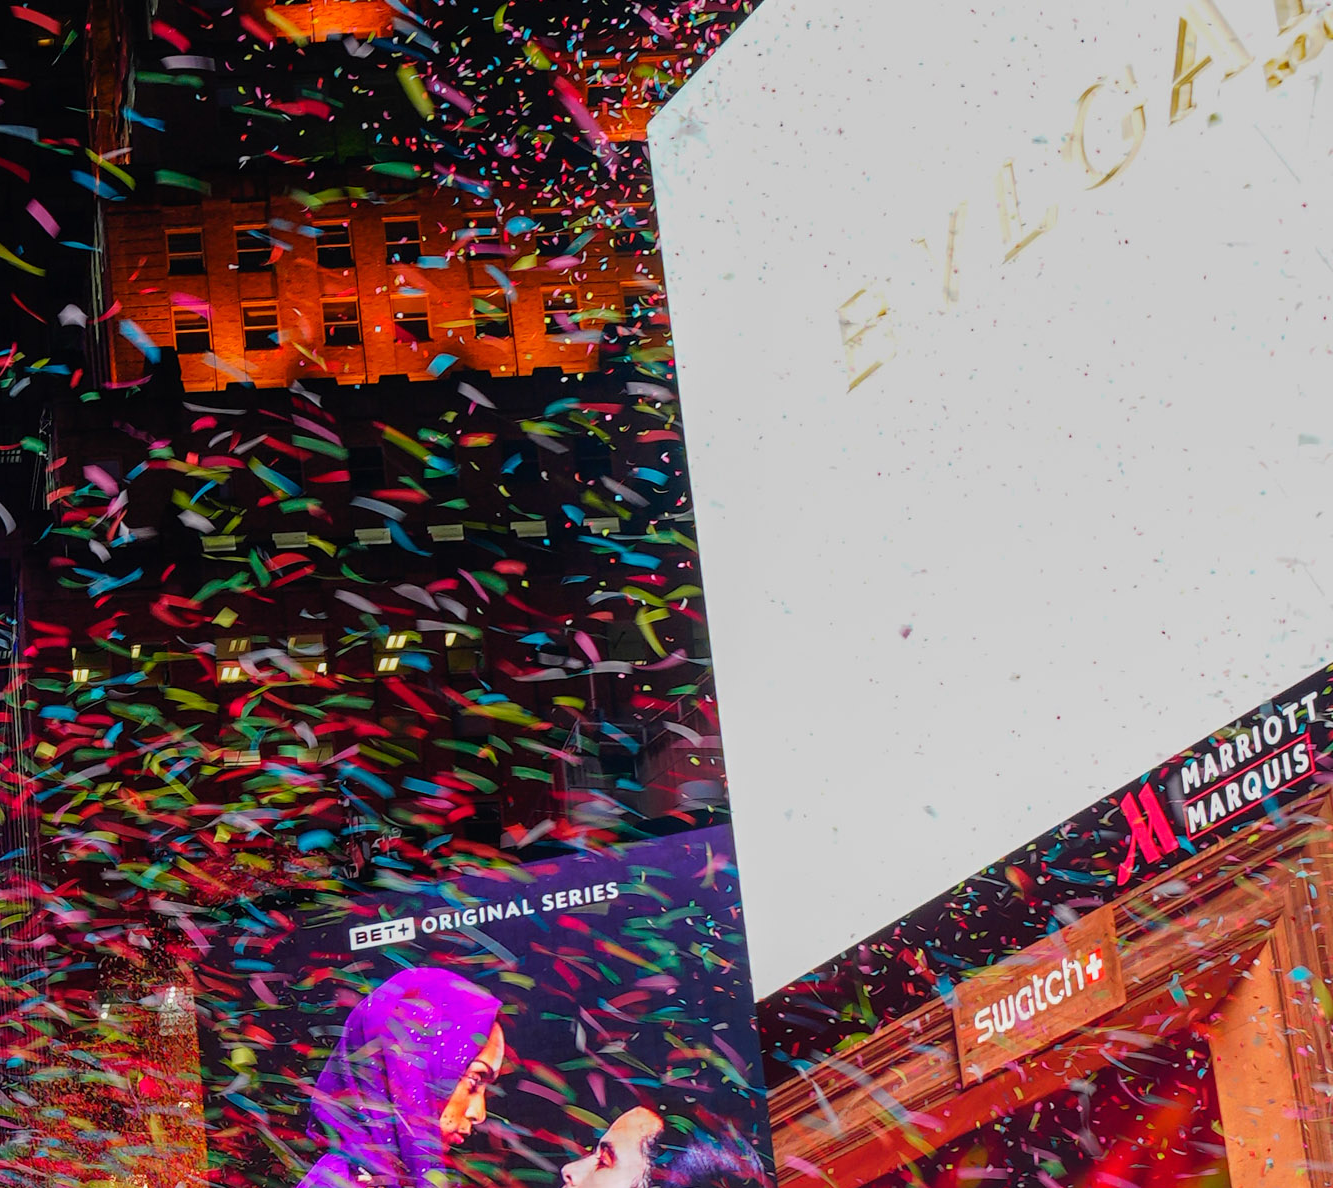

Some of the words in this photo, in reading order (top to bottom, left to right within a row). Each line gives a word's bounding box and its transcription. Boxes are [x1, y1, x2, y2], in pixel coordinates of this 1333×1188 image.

[1180, 691, 1319, 794] MARRIOTT
[1187, 742, 1311, 834] MARQUIS
[421, 898, 535, 934] ORIGINAL
[541, 882, 620, 912] SERIES
[974, 950, 1084, 1044] swatch
